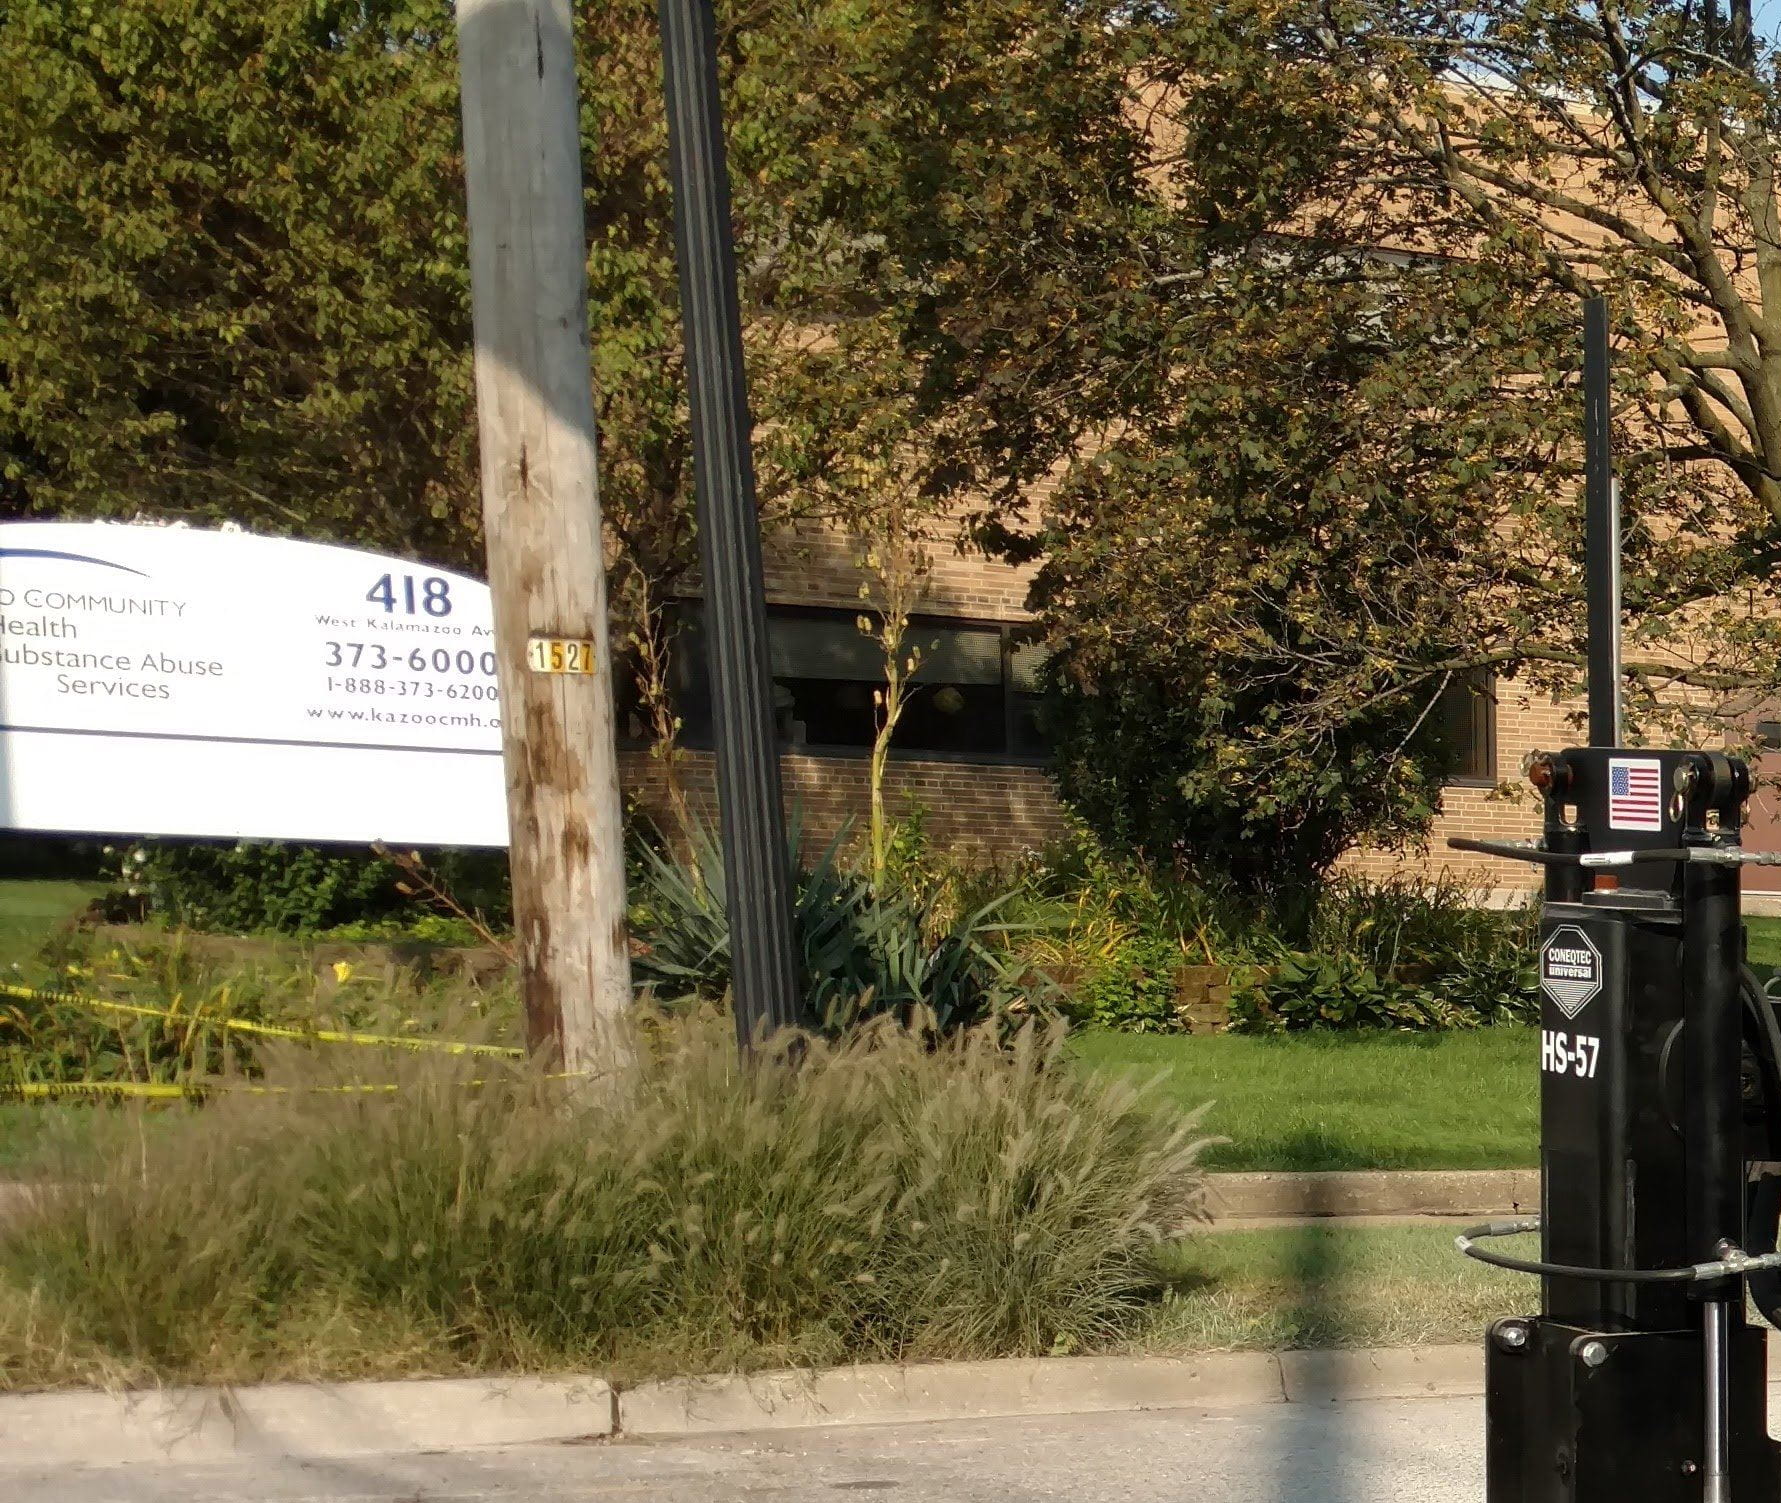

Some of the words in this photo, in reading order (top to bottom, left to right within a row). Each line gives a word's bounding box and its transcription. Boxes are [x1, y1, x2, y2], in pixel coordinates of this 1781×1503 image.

[24, 589, 186, 617] COMMUNITY
[366, 573, 453, 617] 418
[315, 614, 356, 628] West
[367, 618, 462, 635] Kalamazoo
[472, 625, 497, 637] Av
[0, 643, 131, 670] ubstance
[141, 652, 223, 676] Abuse
[325, 641, 499, 676] 373-6000
[535, 641, 591, 671] 1527
[57, 674, 170, 699] Services
[327, 676, 499, 701] 1-888-373-6200
[307, 707, 502, 728] www.kazoocmh.o
[1548, 948, 1592, 965] CONEQTEC
[1549, 966, 1592, 979] universal
[1542, 1030, 1600, 1078] HS-57
